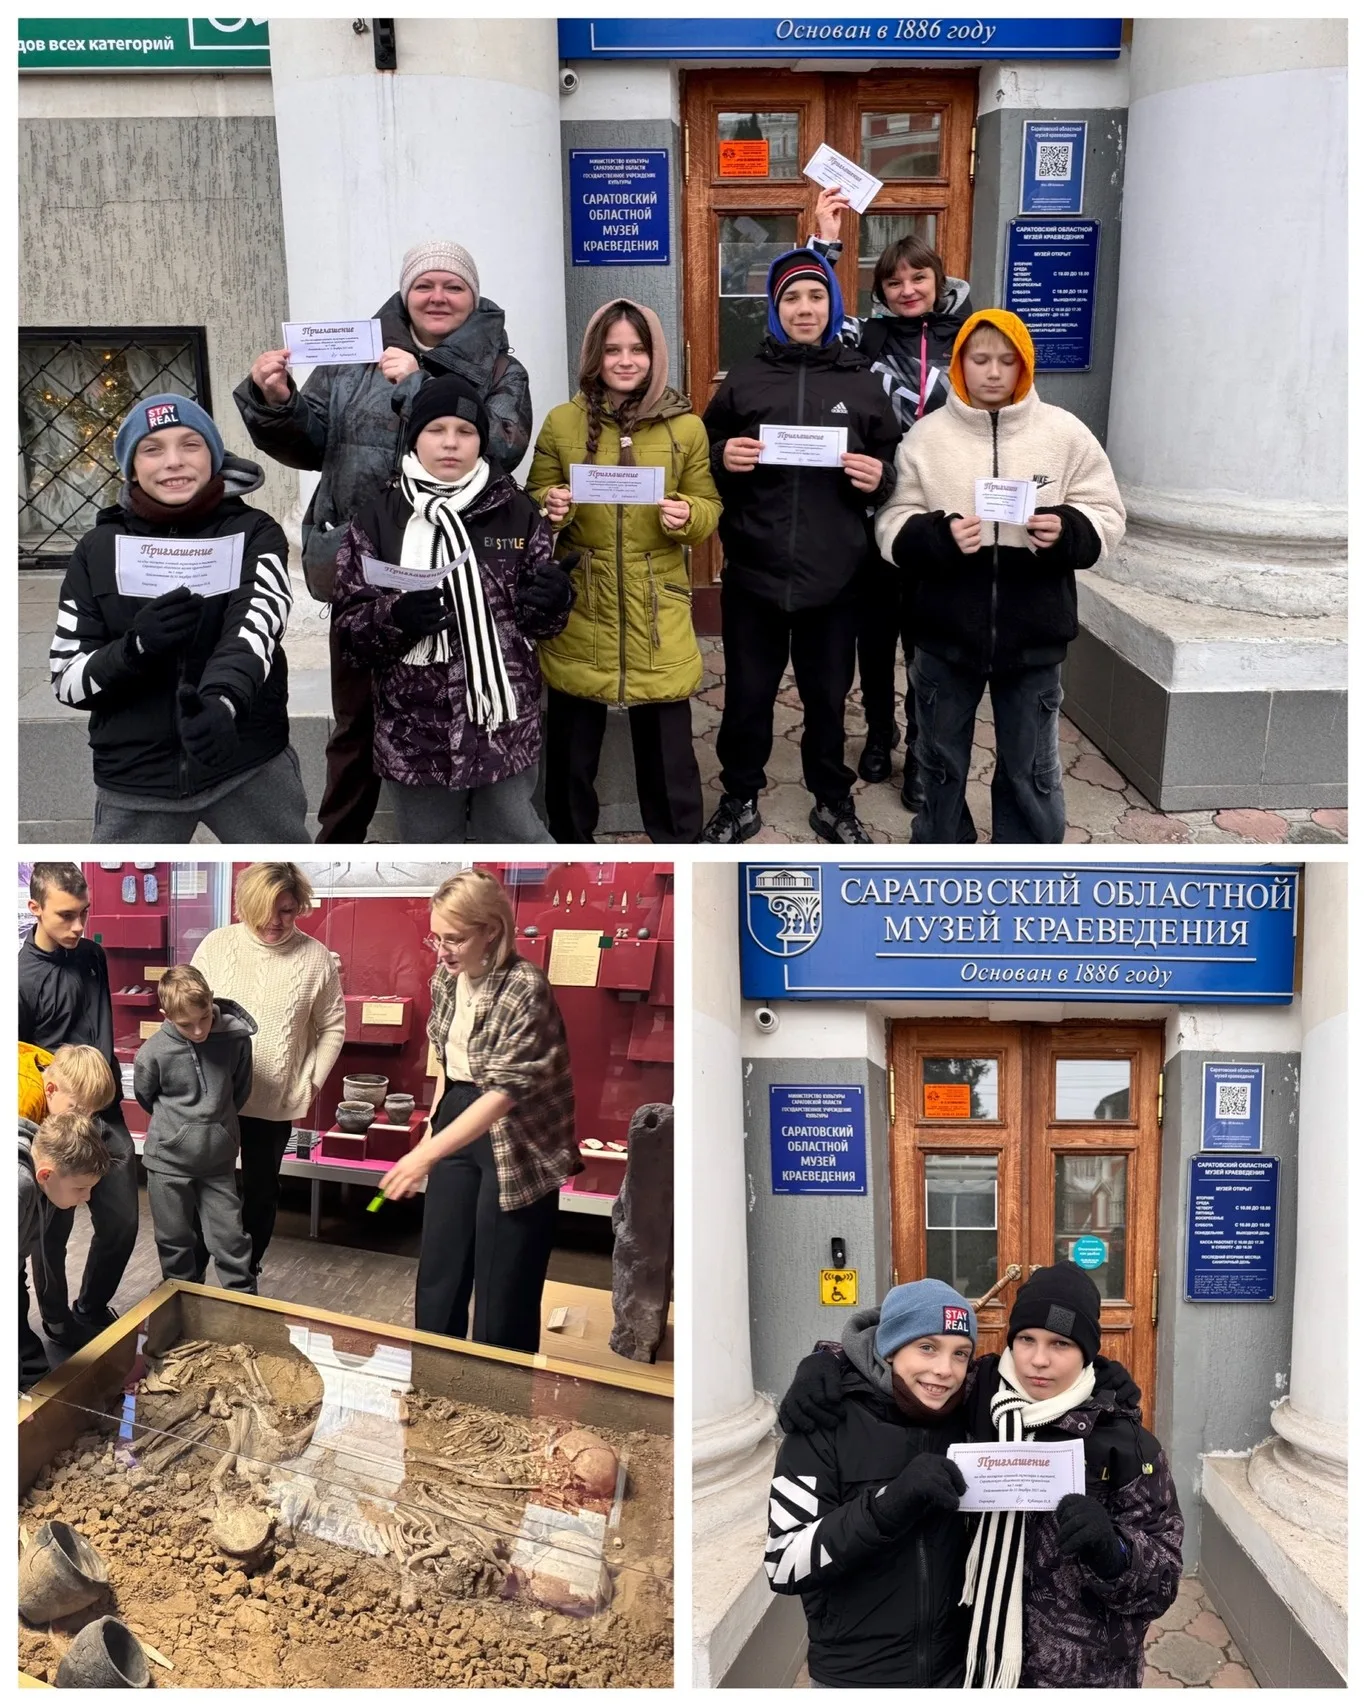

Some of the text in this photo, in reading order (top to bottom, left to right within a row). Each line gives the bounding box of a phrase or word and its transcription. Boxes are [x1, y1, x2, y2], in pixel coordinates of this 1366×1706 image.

[776, 19, 996, 44] Основан в 1886 году
[49, 39, 86, 51] всех
[89, 36, 174, 54] категорий
[583, 191, 657, 205] САРАТОВСКИЙ
[589, 206, 652, 220] ОБЛАСТНОЙ
[603, 222, 639, 236] МУЗЕЙ
[583, 240, 659, 253] КРАЕВЕДЕНИЯ
[302, 326, 354, 336] Приглашение
[148, 406, 175, 417] STAY
[149, 414, 179, 427] REAL
[777, 432, 824, 440] Приглашение
[587, 470, 638, 478] Приглашение
[1033, 474, 1049, 483] NIKE
[484, 536, 525, 550] EX STYLE
[140, 544, 213, 558] Приглашение
[840, 872, 1292, 911] САРАТОВСКИЙ ОБЛАСТНОЙ
[884, 908, 1249, 951] МУЗЕЙ КРАЕВЕДЕНИЯ
[960, 962, 1172, 988] Основан в 1886 году
[782, 1125, 853, 1137] САРАТОВСКИЙ
[788, 1139, 848, 1152] ОБЛАСТНОЙ
[801, 1154, 836, 1167] МУЗЕЙ
[782, 1170, 855, 1182] КРАЕВЕДЕНИЯ
[945, 1310, 967, 1320] STAY
[946, 1320, 969, 1332] REAL
[977, 1455, 1050, 1470] Приглашение
